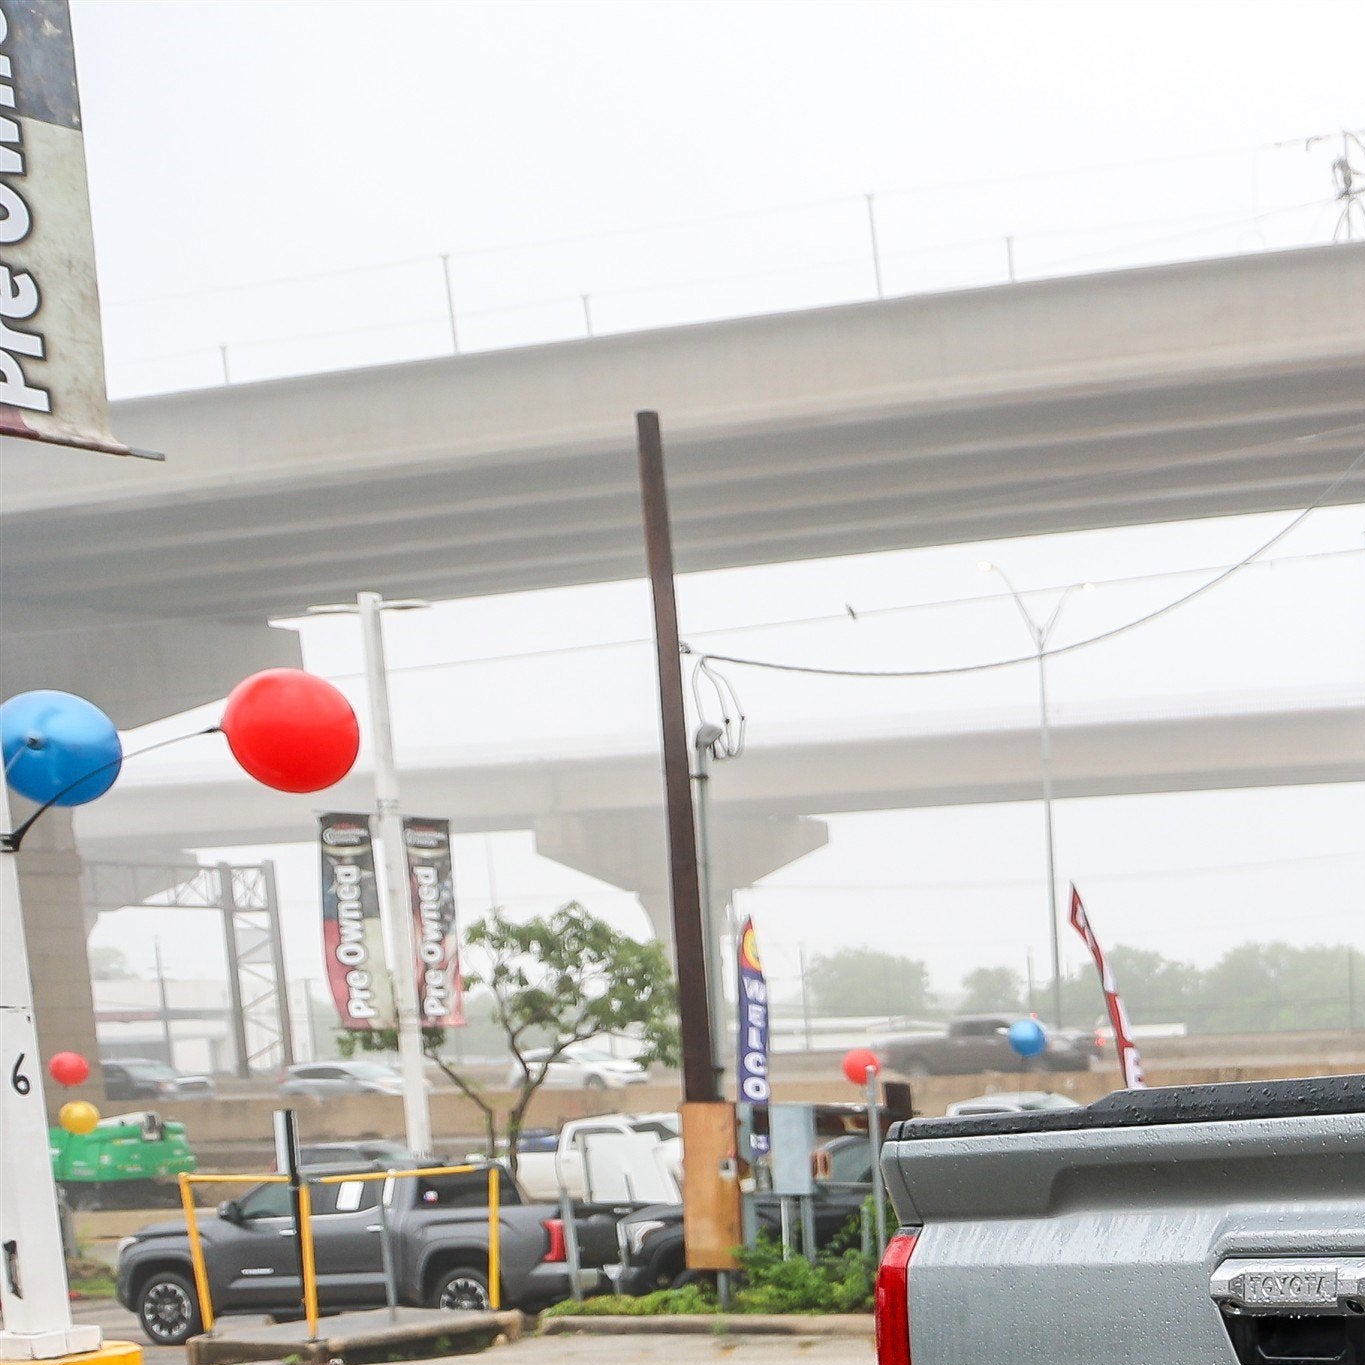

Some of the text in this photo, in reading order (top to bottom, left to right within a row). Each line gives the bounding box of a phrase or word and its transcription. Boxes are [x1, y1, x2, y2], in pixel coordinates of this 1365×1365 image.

[334, 864, 368, 966] Owned
[412, 865, 445, 964] Owned
[346, 969, 378, 1019] Pre
[423, 968, 450, 1017] Pre
[12, 1052, 31, 1096] 6
